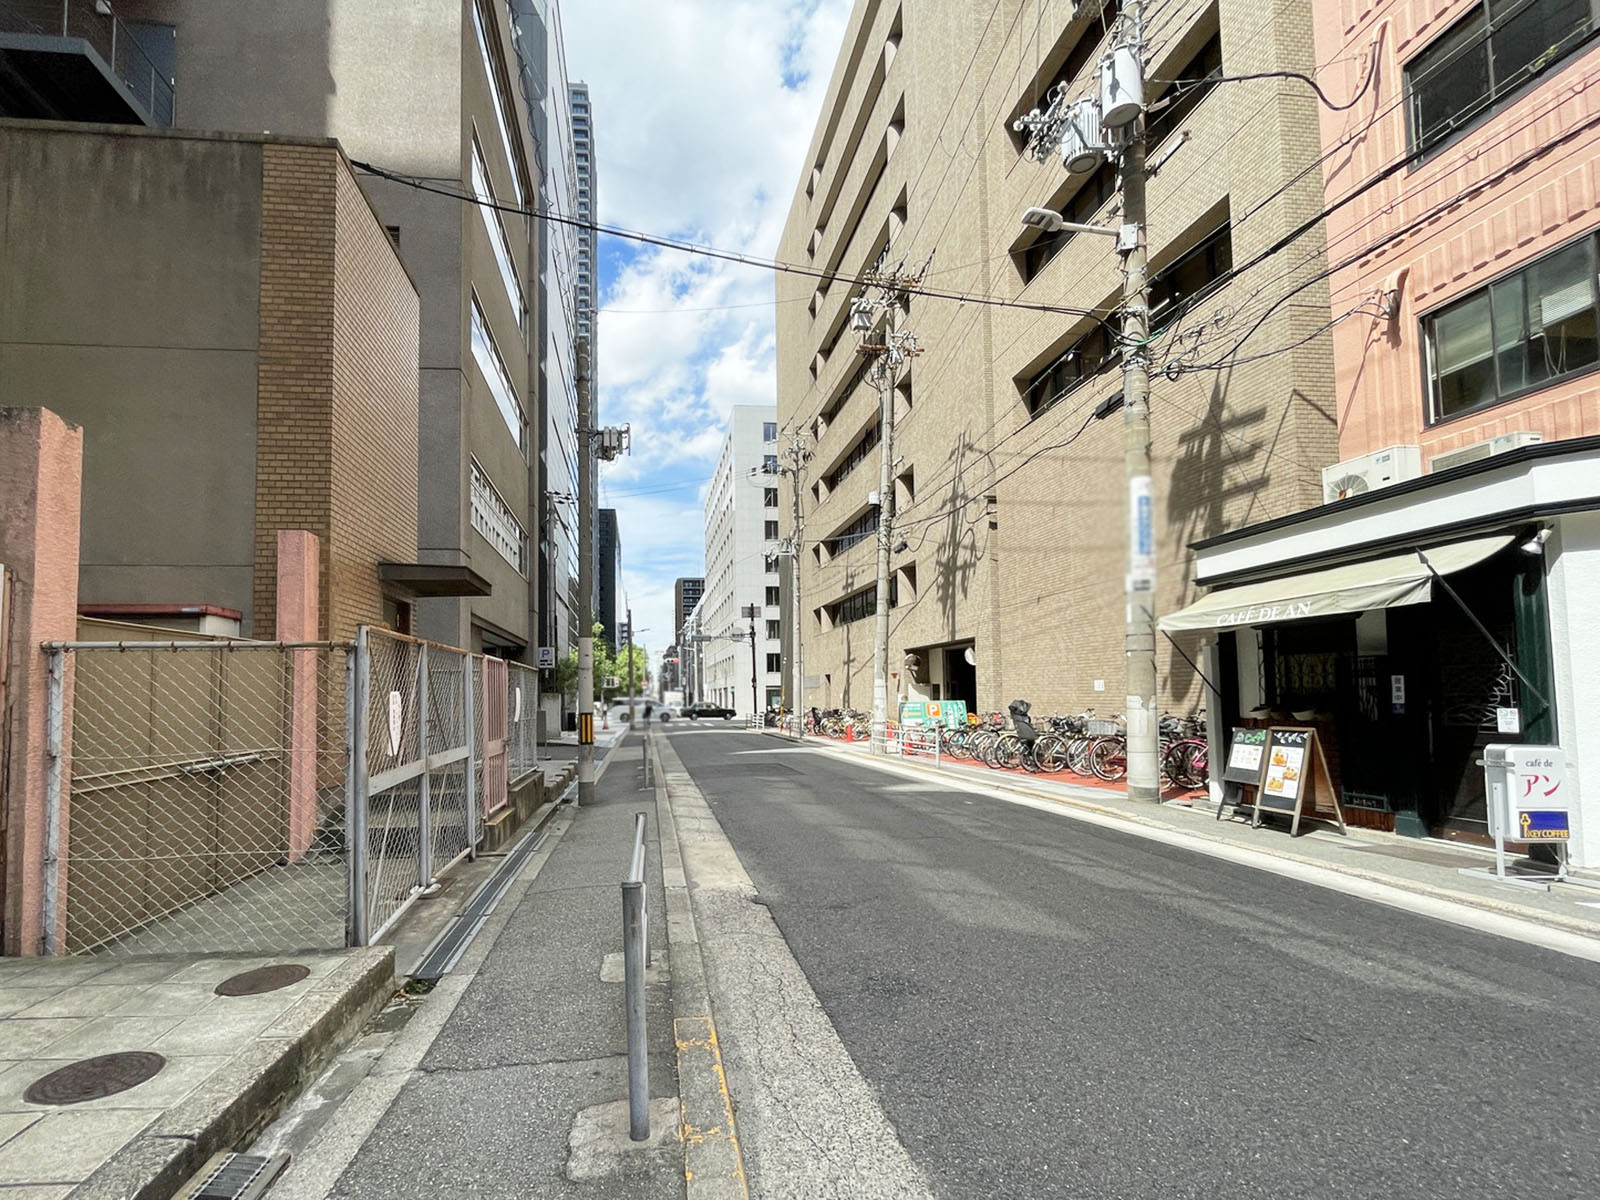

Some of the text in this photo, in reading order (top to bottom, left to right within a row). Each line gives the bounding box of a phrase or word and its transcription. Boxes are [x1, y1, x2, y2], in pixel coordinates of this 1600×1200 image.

[1259, 606, 1281, 620] DE
[1282, 601, 1312, 619] AN
[929, 704, 938, 716] P
[1525, 759, 1542, 767] café
[1519, 774, 1561, 797] アン
[1542, 829, 1569, 838] COFFEE
